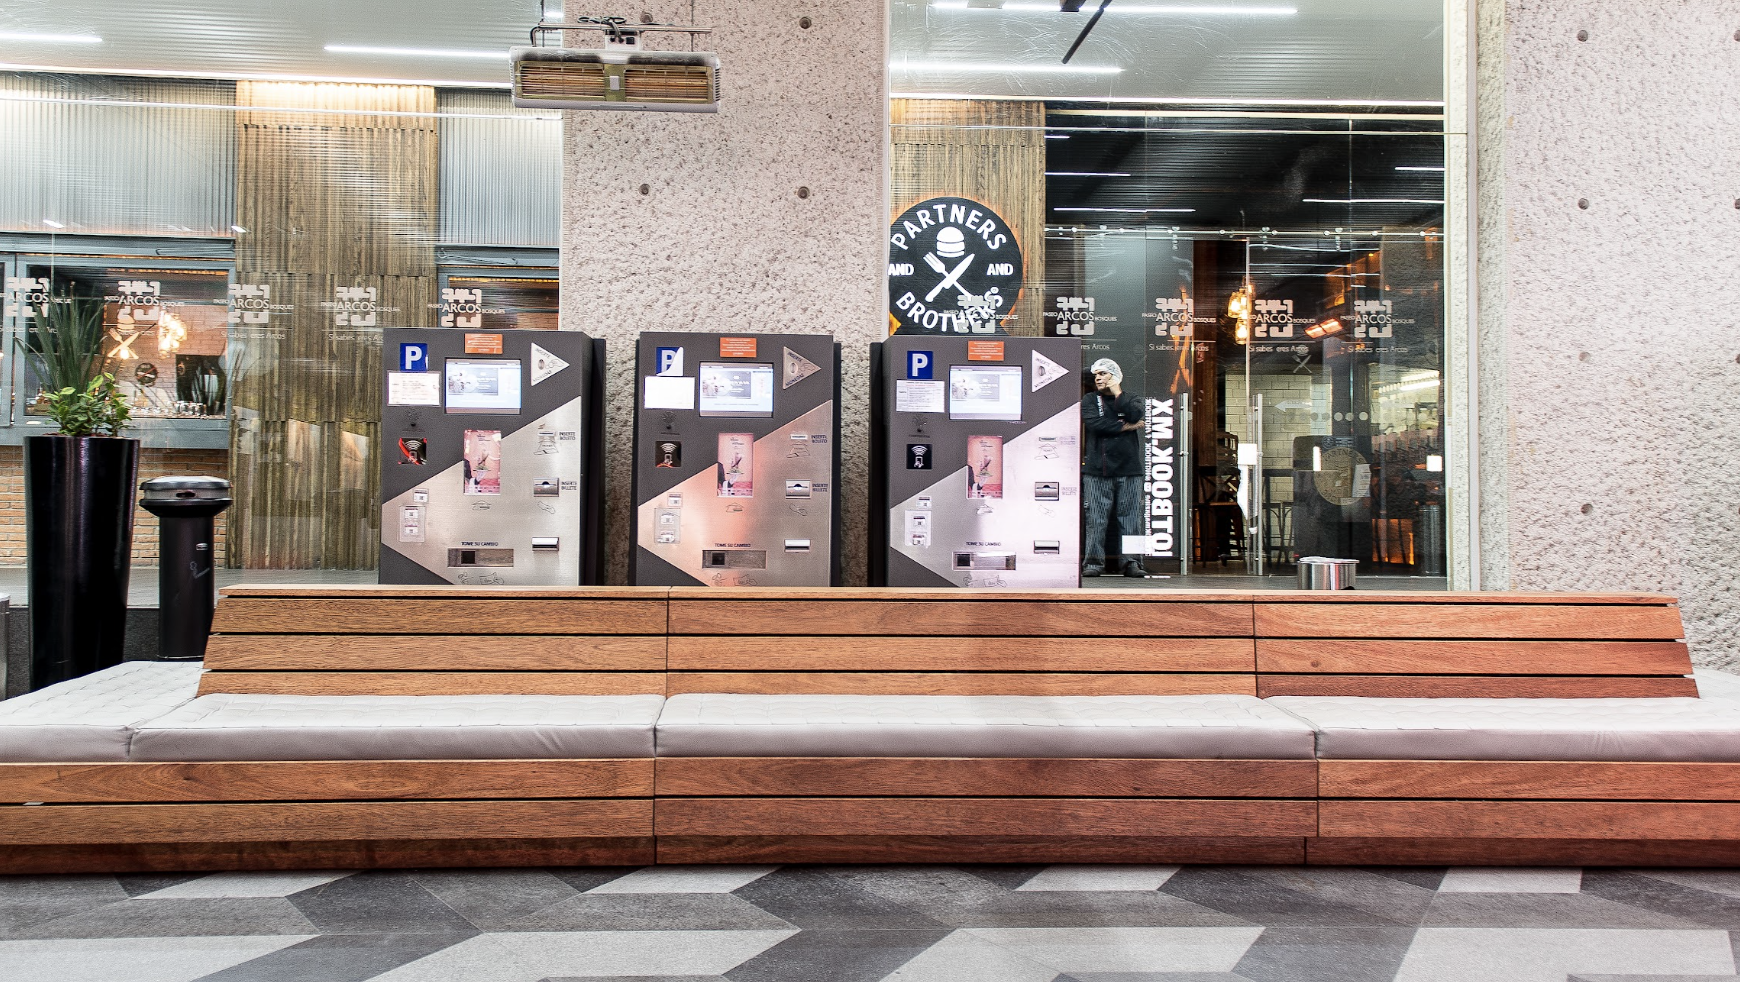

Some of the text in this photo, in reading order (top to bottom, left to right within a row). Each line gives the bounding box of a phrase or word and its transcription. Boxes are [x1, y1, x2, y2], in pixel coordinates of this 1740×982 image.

[890, 204, 1007, 250] PARTNERS
[888, 263, 915, 276] AND
[986, 263, 1014, 276] AND
[8, 292, 49, 302] ARCOS
[118, 296, 160, 305] ARCOS
[228, 299, 269, 308] ARCOS
[337, 301, 376, 311] ARCOS
[442, 303, 481, 313] ARCOS
[1057, 311, 1094, 320] ARCOS
[1156, 313, 1193, 322] ARCOS
[1255, 314, 1293, 323] ARCOS
[1355, 314, 1392, 323] ARCOS
[405, 346, 422, 370] P
[912, 353, 928, 377] P
